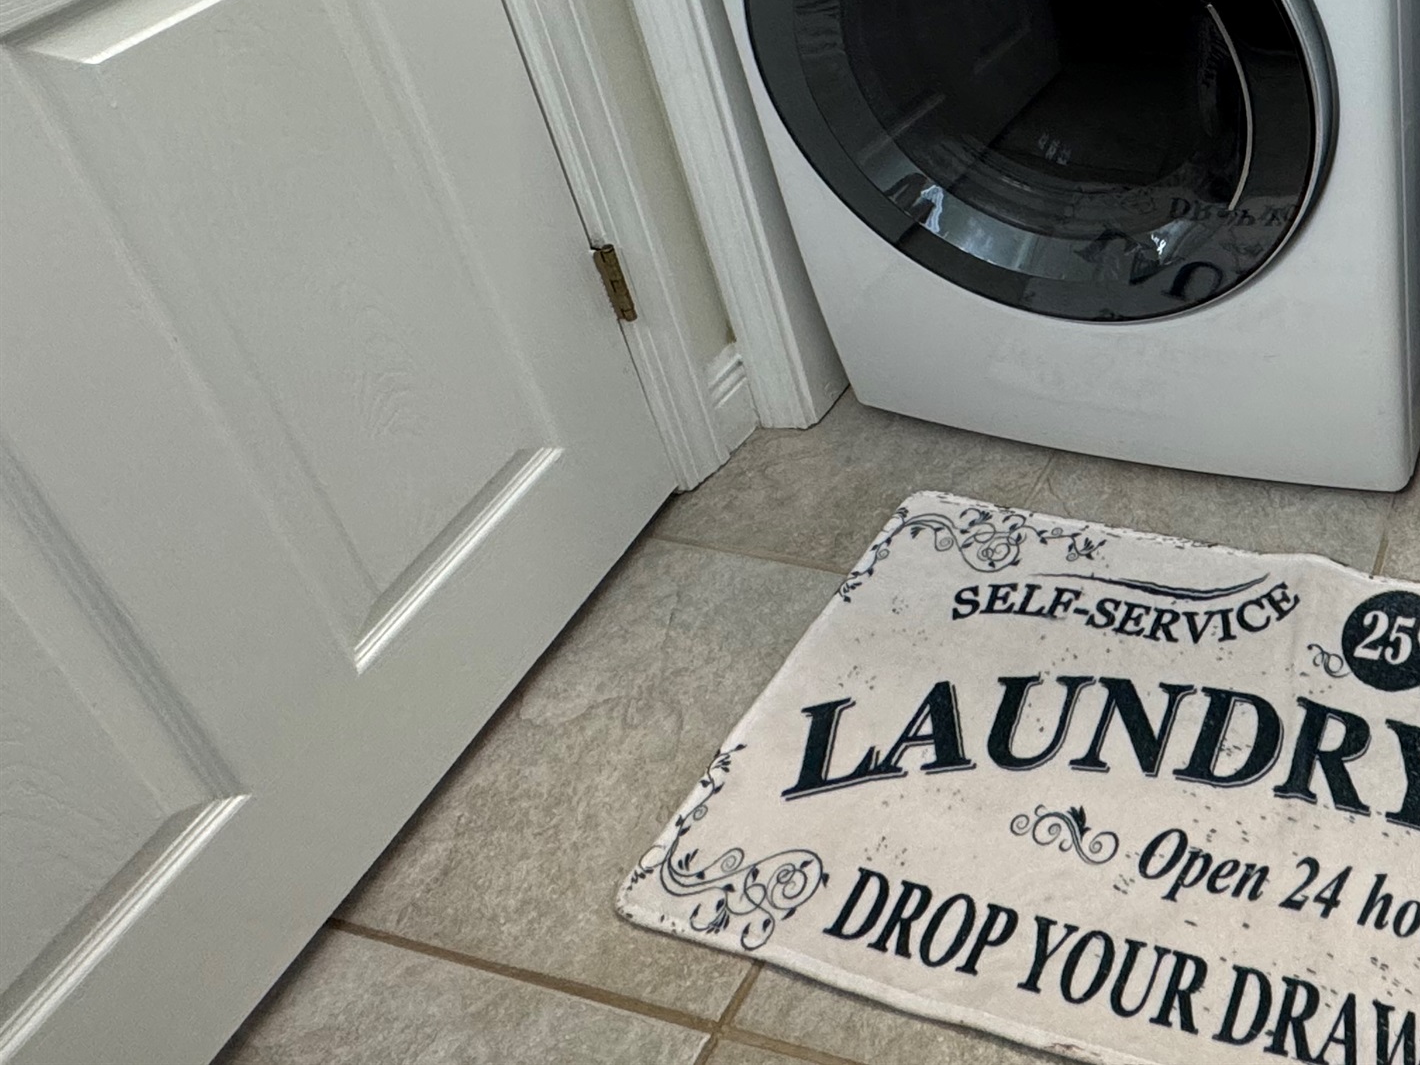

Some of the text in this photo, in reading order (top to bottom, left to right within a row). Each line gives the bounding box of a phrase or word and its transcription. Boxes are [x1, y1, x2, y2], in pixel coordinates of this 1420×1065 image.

[951, 579, 1300, 644] SELF-SERVICE
[1138, 828, 1269, 903] Open
[1279, 855, 1344, 919] 24
[822, 867, 1018, 977] DROP
[1016, 914, 1209, 1035] YOUR
